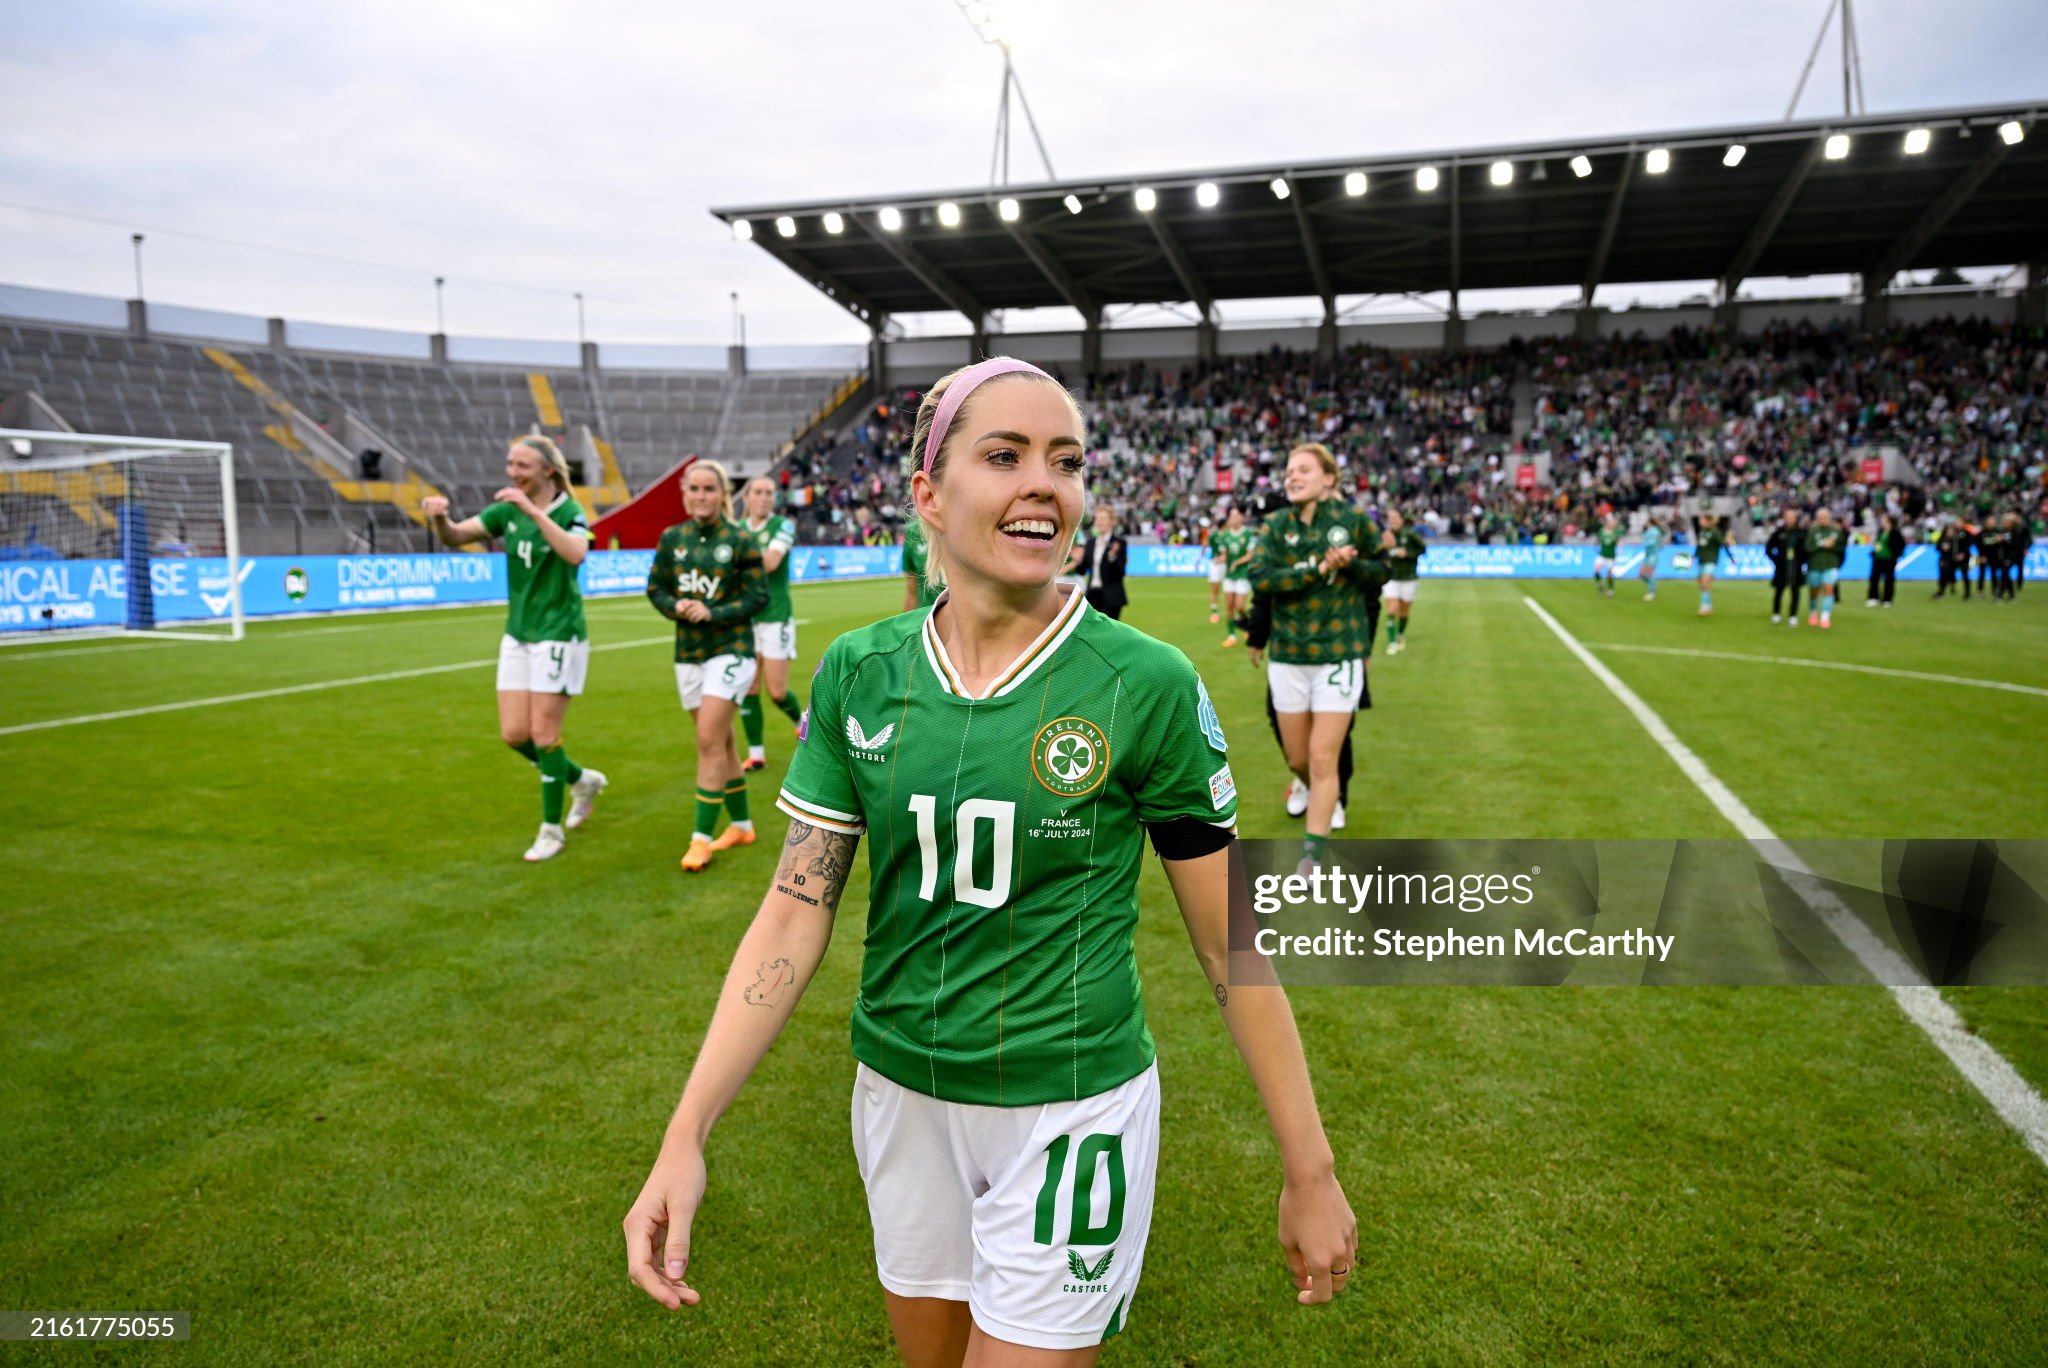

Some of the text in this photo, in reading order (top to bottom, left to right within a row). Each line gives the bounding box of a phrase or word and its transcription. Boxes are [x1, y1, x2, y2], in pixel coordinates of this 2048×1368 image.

[517, 540, 533, 569] 4
[0, 563, 188, 602] ICAL ABSE
[337, 557, 493, 588] DISCRIMINATION
[678, 568, 721, 599] sky
[550, 645, 564, 672] 4
[1040, 721, 1103, 748] IRELAND
[1045, 777, 1092, 793] FOOTBALL
[1041, 818, 1081, 828] FRANCE
[1060, 808, 1068, 818] V
[1044, 829, 1069, 839] JULY
[1071, 828, 1090, 838] 2024
[908, 794, 1016, 909] 10
[793, 873, 806, 886] 10
[776, 884, 819, 907] RESILIENCE
[1034, 1132, 1127, 1246] 10
[1063, 1284, 1108, 1294] CASTORE
